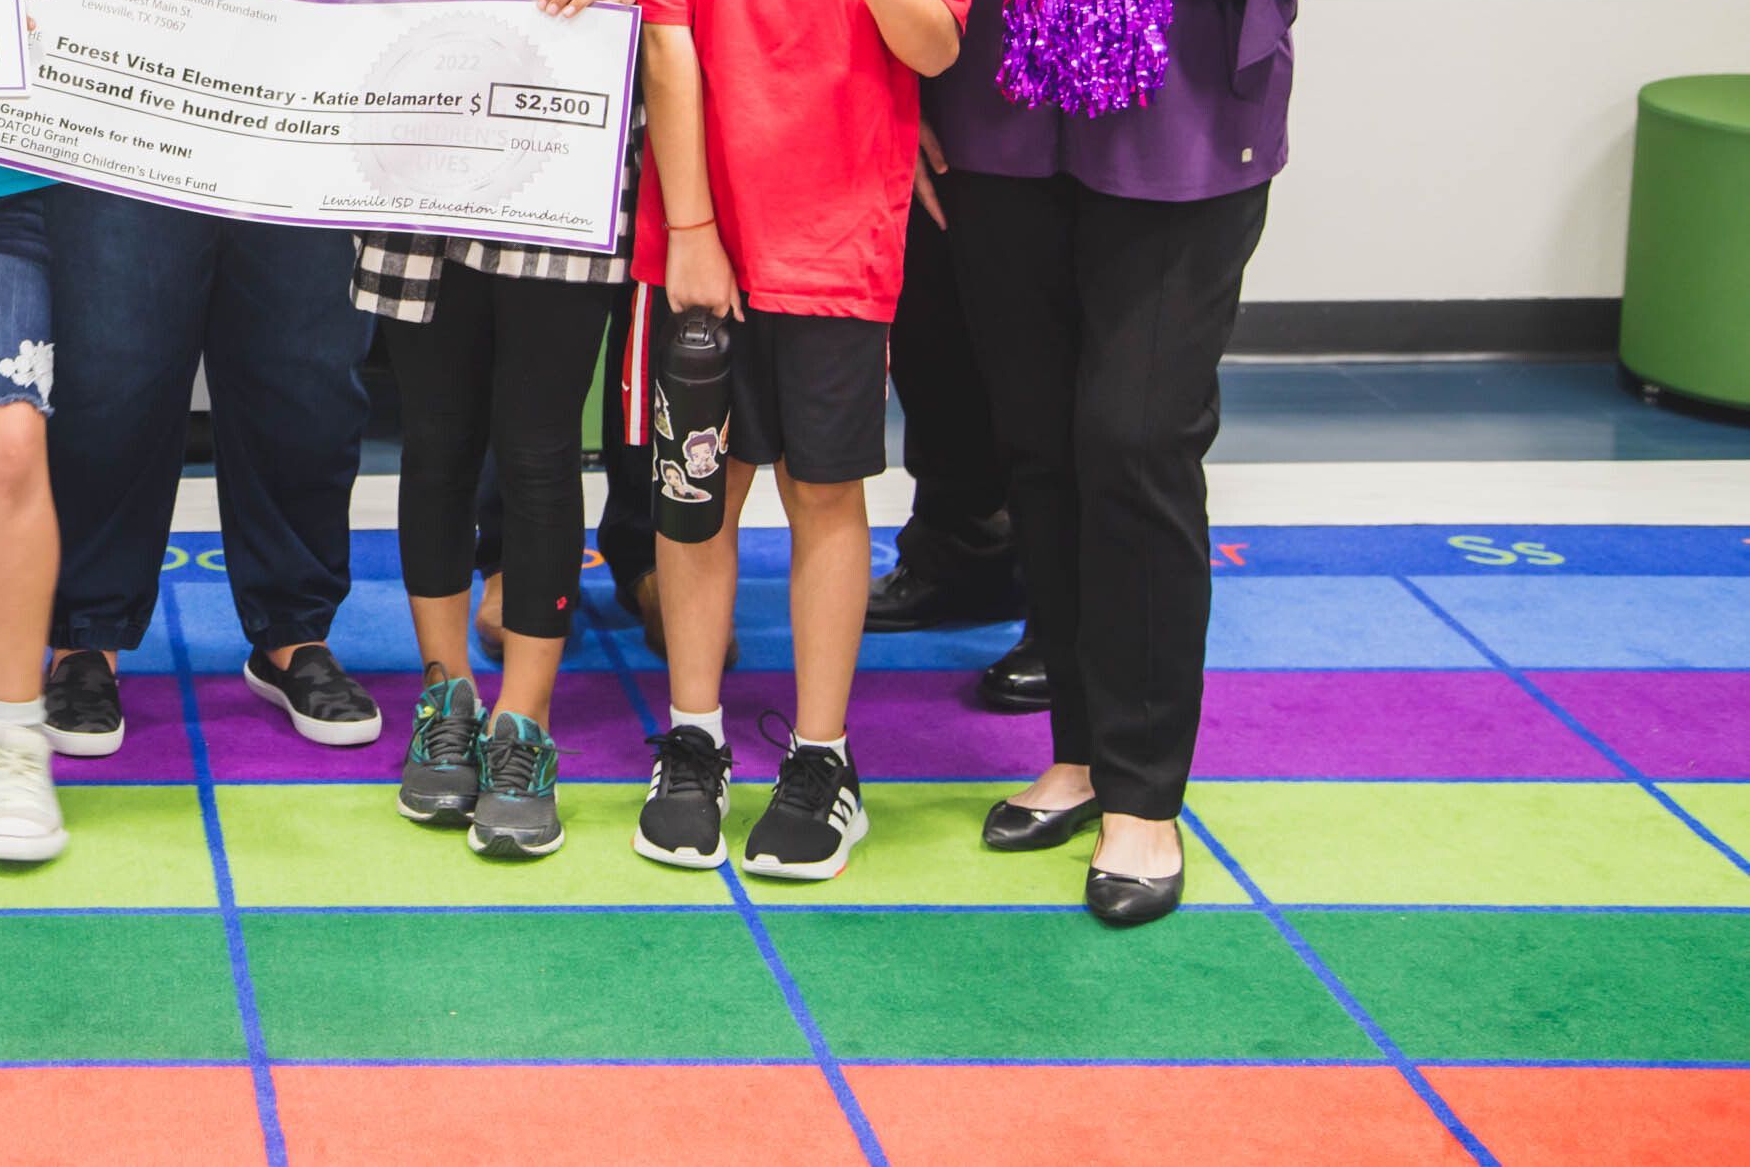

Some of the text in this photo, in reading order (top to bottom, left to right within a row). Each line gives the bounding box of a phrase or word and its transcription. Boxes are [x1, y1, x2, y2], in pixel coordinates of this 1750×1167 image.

[138, 11, 151, 24] TX
[179, 5, 193, 19] St.
[56, 35, 120, 66] Forest
[126, 52, 176, 80] Vista
[182, 68, 297, 108] Elementary
[313, 90, 360, 107] Katie
[364, 91, 463, 109] Delamarter
[37, 63, 341, 137] thousand five hundred dollars
[469, 93, 591, 117] $ $2,500
[0, 103, 193, 160] Graphic Novels for the WIN!
[44, 128, 79, 148] Grant
[510, 137, 571, 156] DOLLARS
[20, 137, 80, 164] Changing
[82, 152, 146, 177] Children's
[149, 167, 182, 186] Lives
[185, 176, 218, 193] Fund
[322, 193, 594, 227] Lewisville ISD Education Foundation
[1447, 535, 1567, 566] Ss
